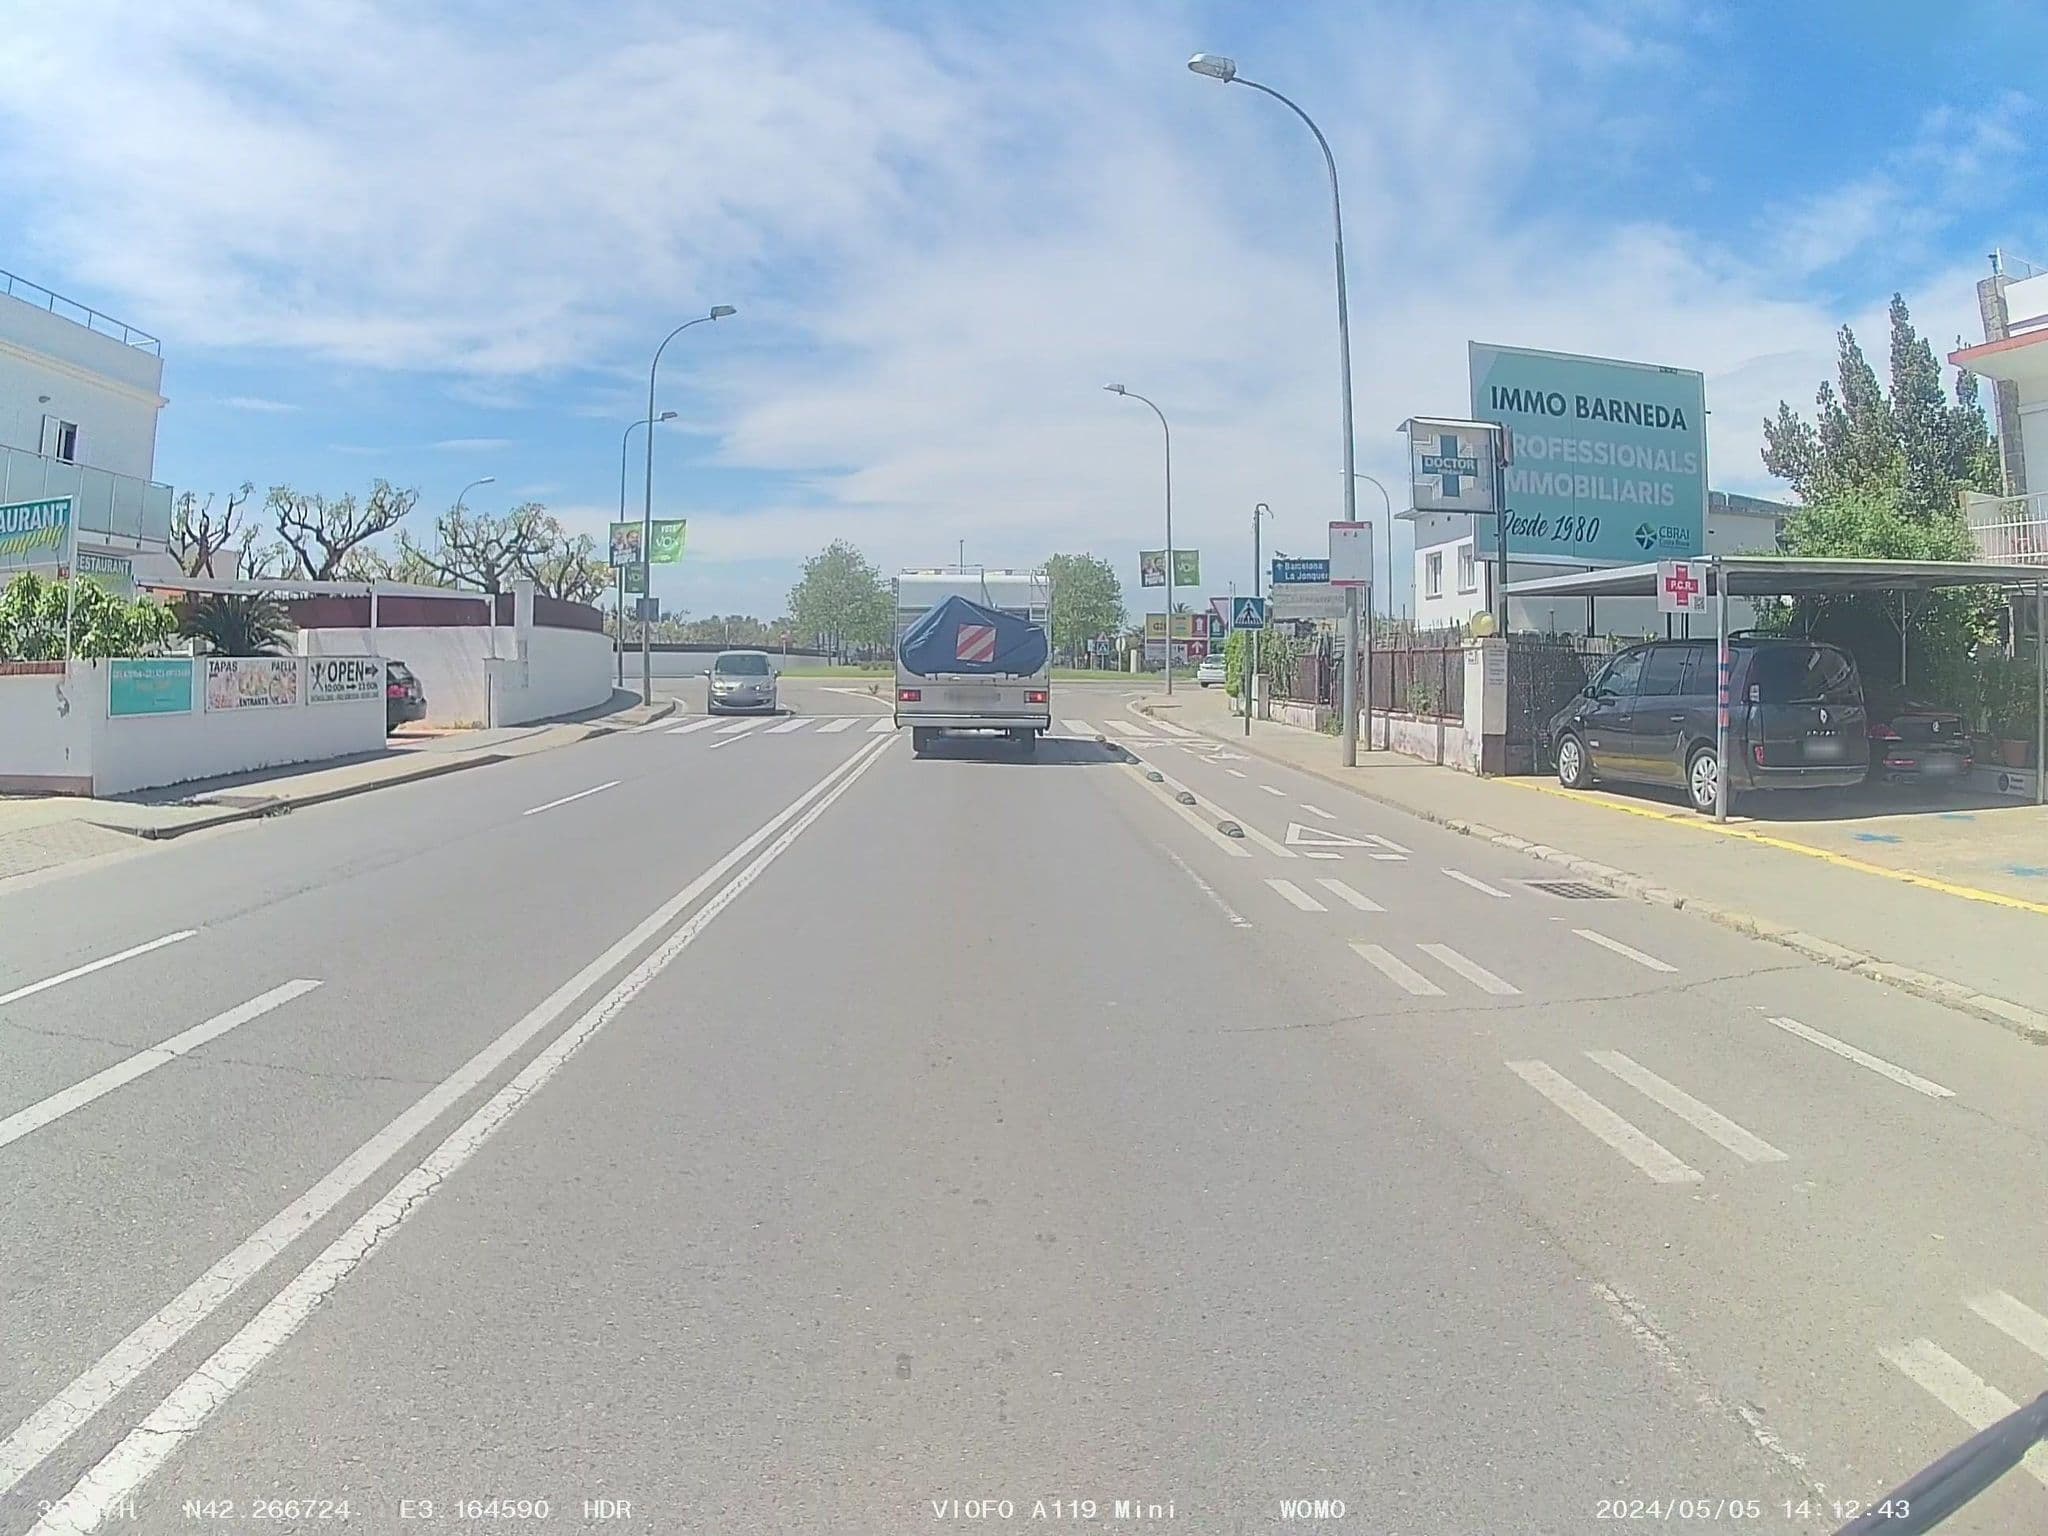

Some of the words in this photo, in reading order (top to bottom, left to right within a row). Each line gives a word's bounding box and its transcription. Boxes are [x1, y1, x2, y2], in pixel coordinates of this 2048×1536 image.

[1491, 385, 1567, 418] IMMO
[1575, 395, 1688, 431] BARNEDA
[1424, 457, 1476, 470] DOCTOR
[1511, 432, 1698, 475] ROFESSIONALS
[1507, 469, 1675, 506] MMOBILIARIS
[0, 503, 68, 533] AURANT
[1503, 508, 1548, 538] Desde
[1551, 515, 1600, 544] 1980
[655, 535, 680, 549] VOX
[79, 555, 131, 578] ESTAURANT
[1284, 561, 1323, 571] Barcelona
[1284, 571, 1296, 581] La
[1297, 571, 1329, 582] Jonquer
[209, 661, 238, 673] TAPAS
[271, 660, 297, 673] PAELLA
[327, 660, 364, 683] OPEN
